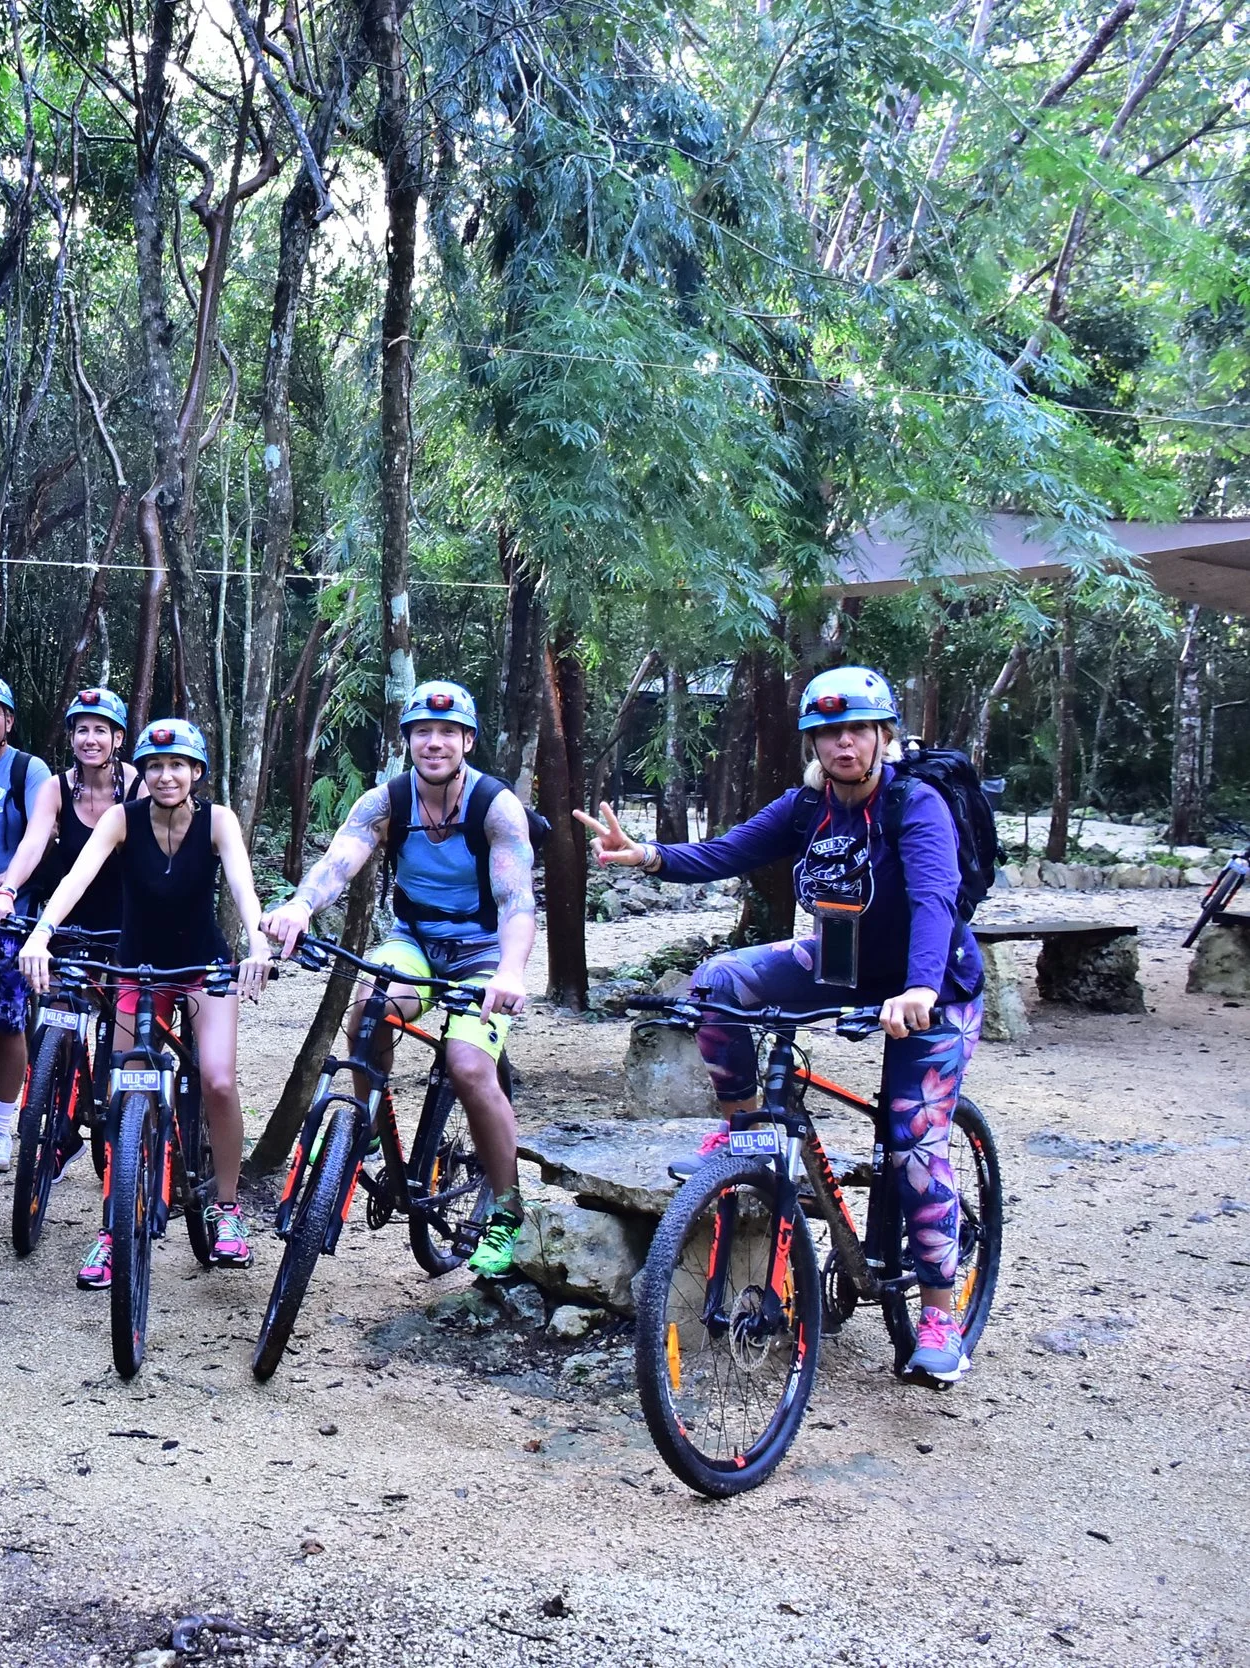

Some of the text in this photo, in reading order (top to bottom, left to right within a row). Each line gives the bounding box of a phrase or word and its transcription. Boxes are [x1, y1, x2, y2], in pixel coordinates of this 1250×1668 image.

[121, 1073, 156, 1084] WILD-019
[732, 1134, 774, 1147] WILD-006
[776, 1216, 794, 1260] XCT
